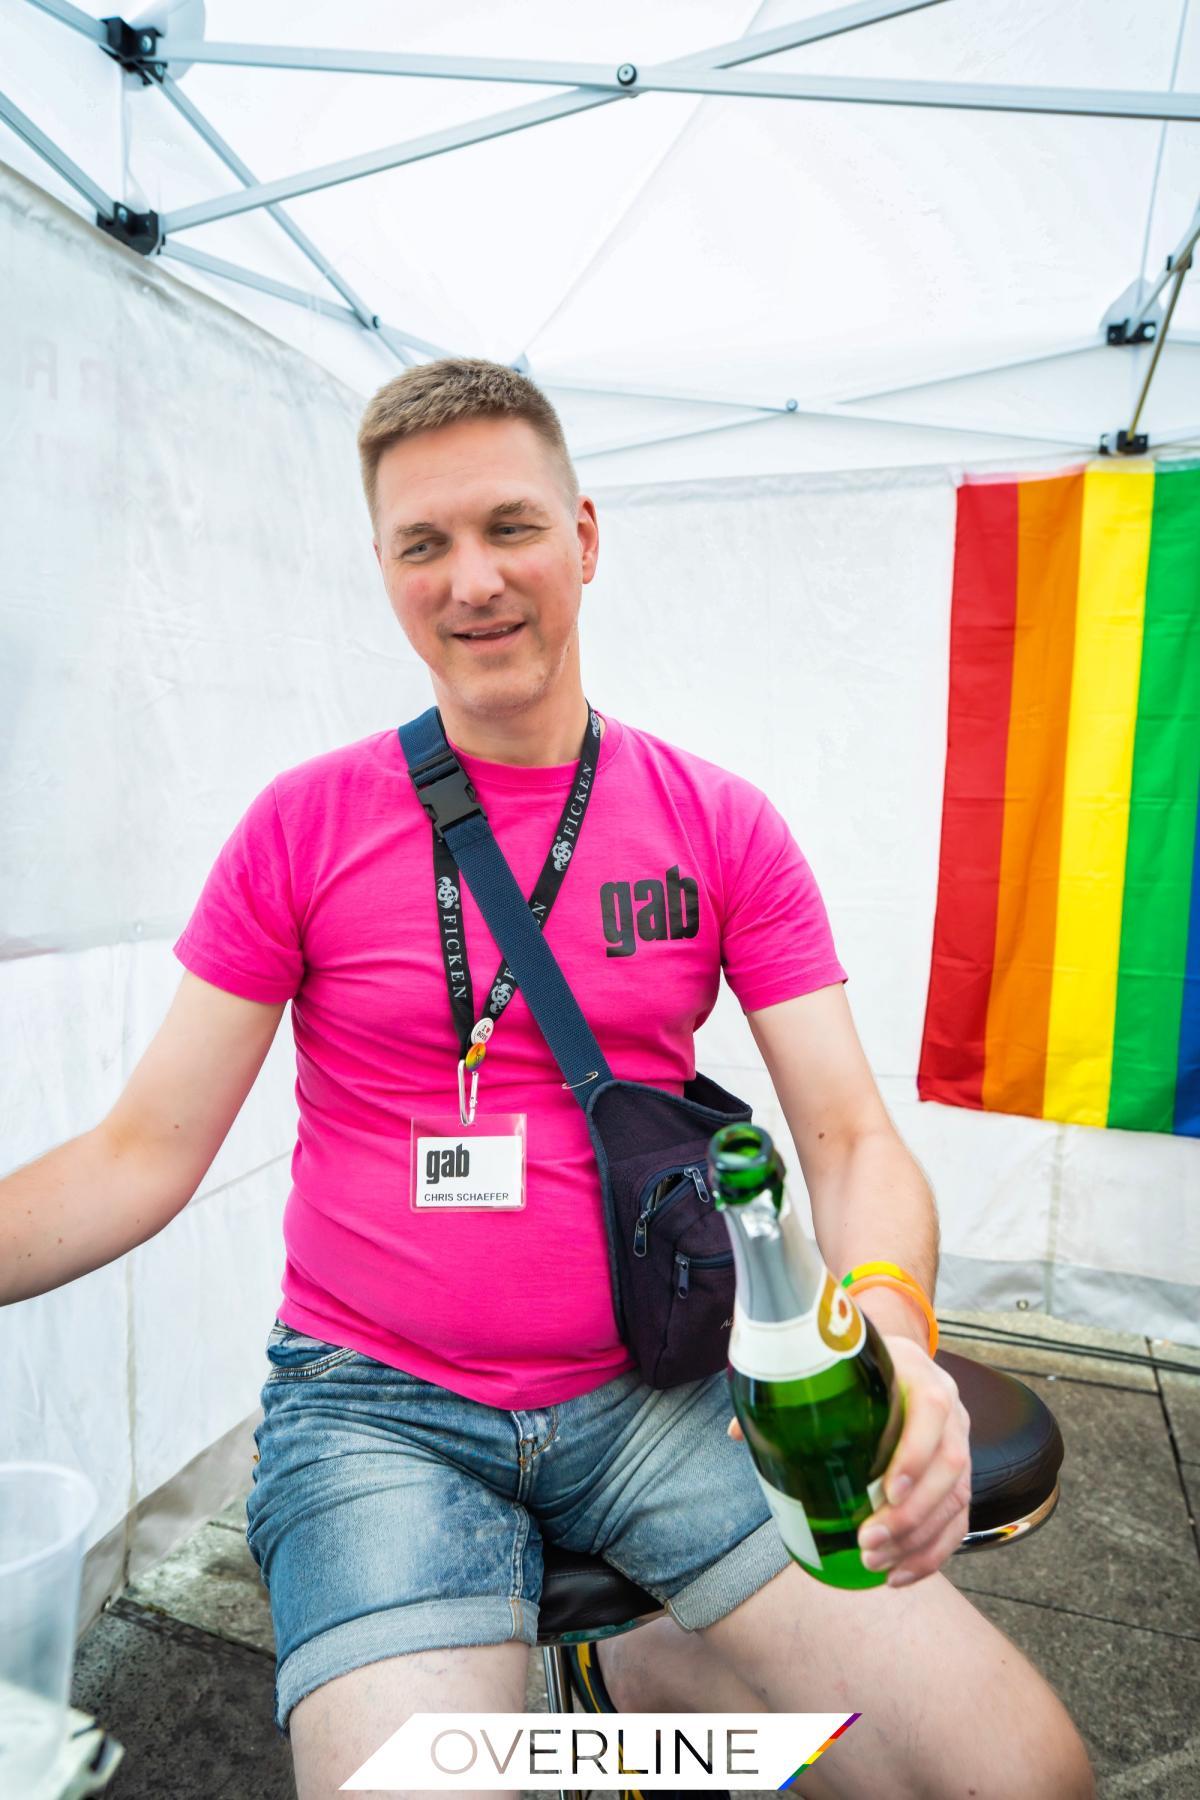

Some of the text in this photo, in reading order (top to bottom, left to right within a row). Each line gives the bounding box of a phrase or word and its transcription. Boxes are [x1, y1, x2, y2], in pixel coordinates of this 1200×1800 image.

[563, 763, 593, 838] FICKEN
[600, 864, 700, 957] gab
[443, 914, 467, 999] FICKEN
[424, 1192, 509, 1202] CHRIS SCHAEFER
[426, 1143, 470, 1185] gab
